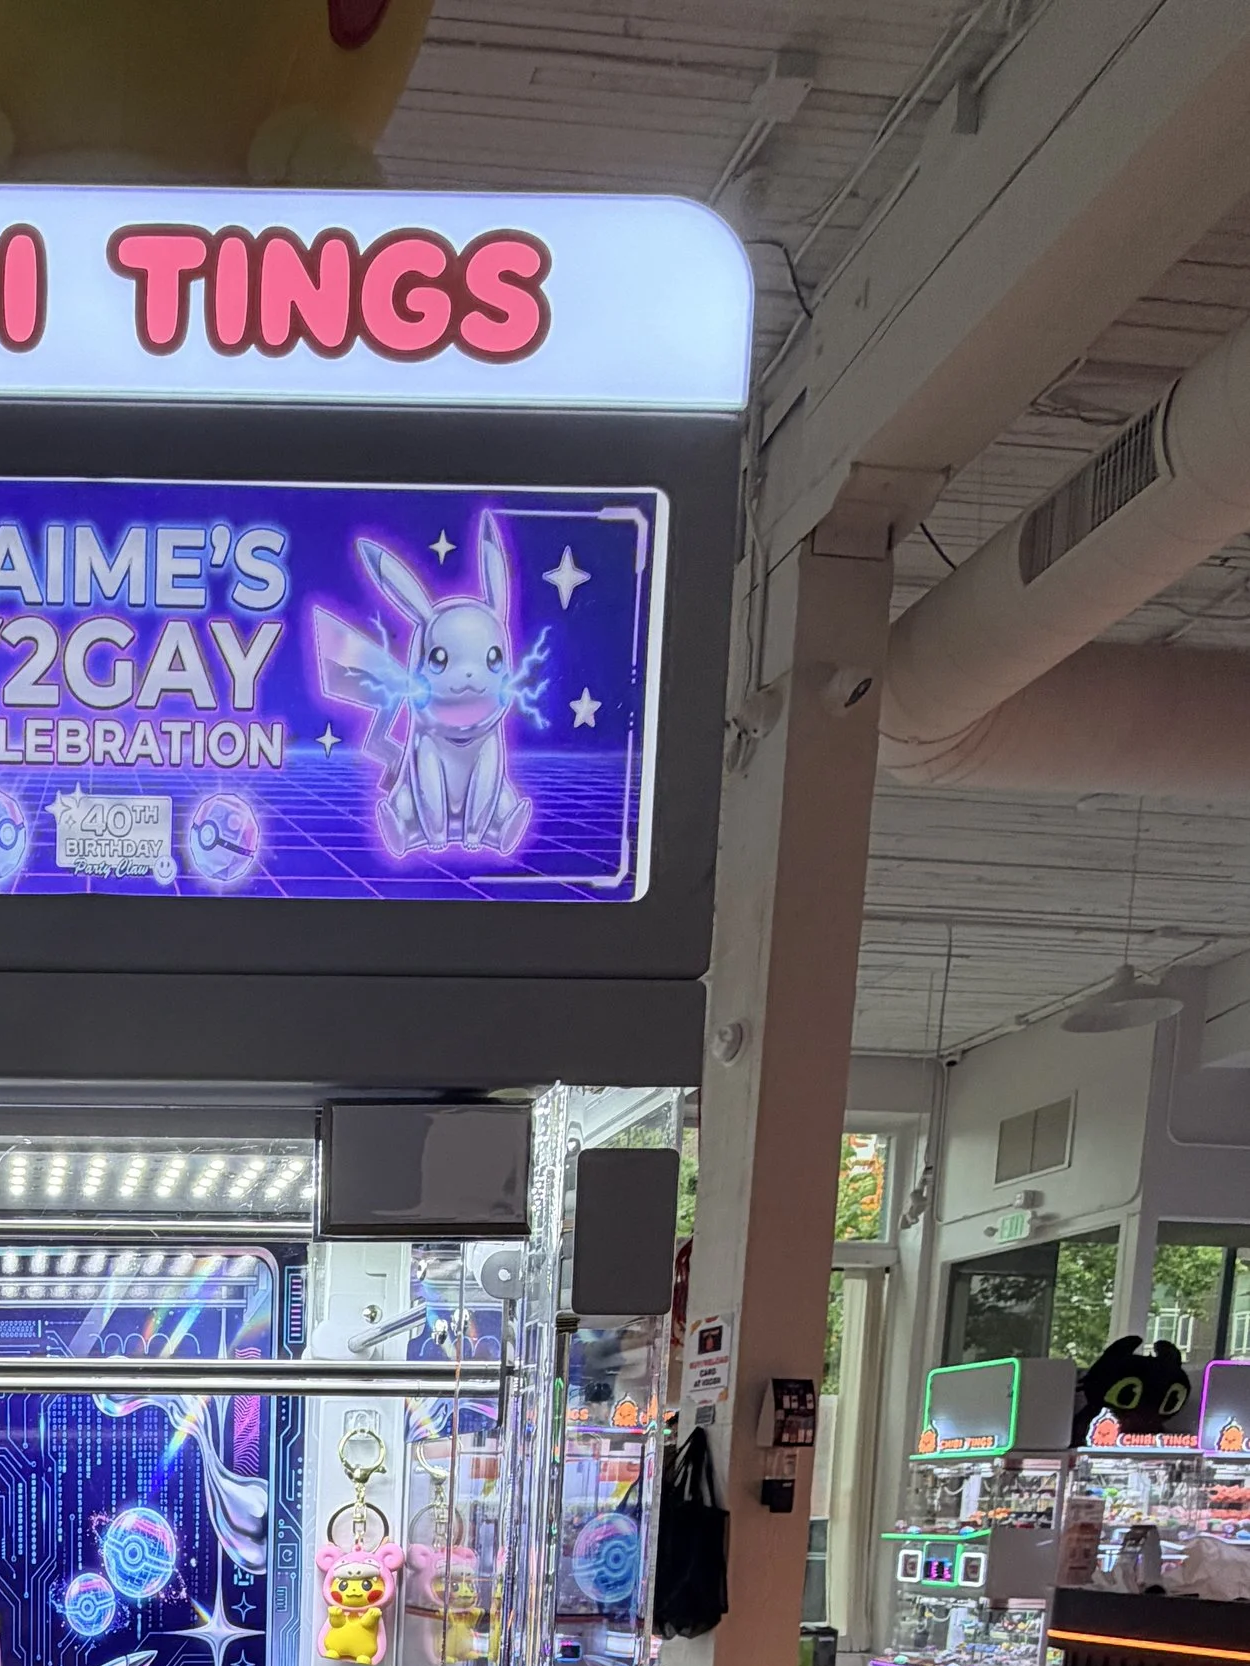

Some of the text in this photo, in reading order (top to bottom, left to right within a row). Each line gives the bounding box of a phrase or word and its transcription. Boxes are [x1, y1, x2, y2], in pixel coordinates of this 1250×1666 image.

[105, 223, 552, 365] TINGS
[80, 803, 160, 838] 40TH
[64, 837, 163, 858] BIRTHDAY
[73, 857, 150, 879] Party Claw
[1122, 1433, 1198, 1447] CHIBI TINGS
